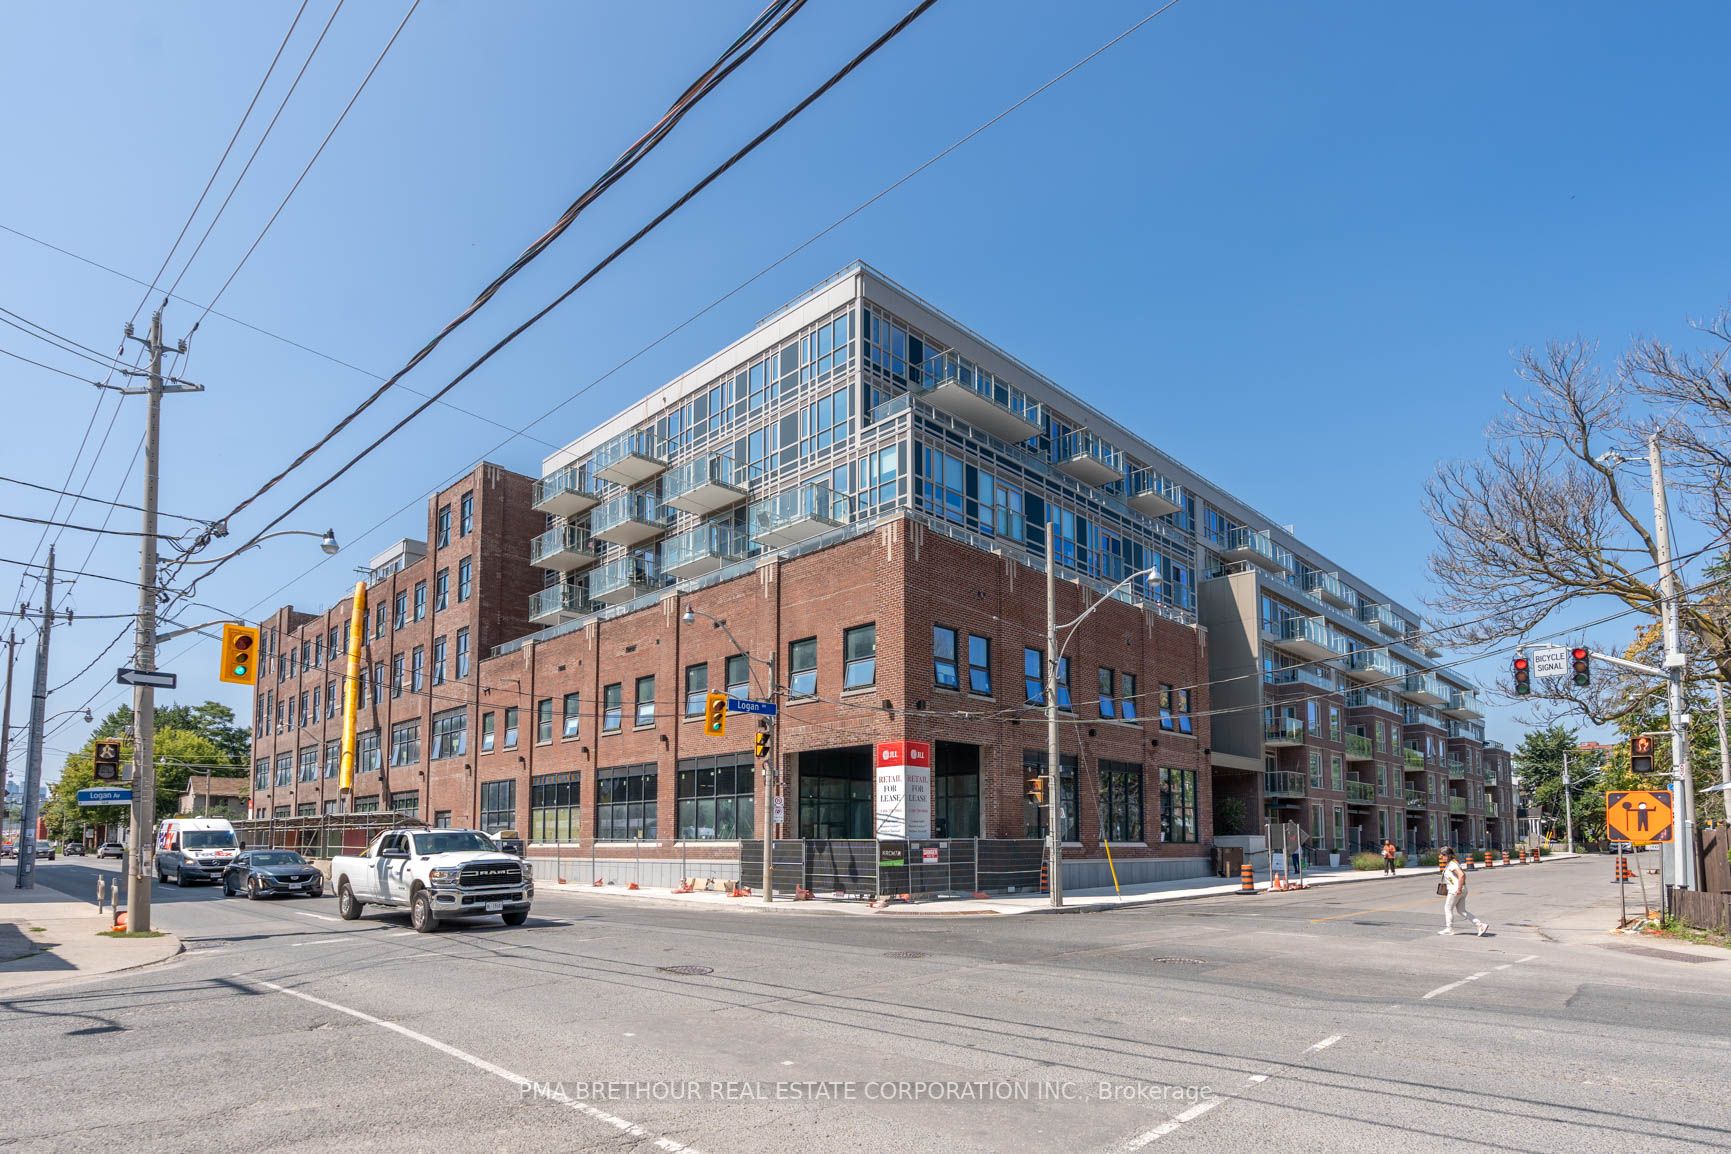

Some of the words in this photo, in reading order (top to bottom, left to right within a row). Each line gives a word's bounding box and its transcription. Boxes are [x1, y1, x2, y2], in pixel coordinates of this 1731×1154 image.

[1535, 652, 1565, 663] BICYCLE
[1537, 663, 1563, 671] SIGNAL
[737, 700, 760, 712] Logan
[878, 775, 902, 784] RETAIL
[908, 776, 928, 784] RETAIL
[90, 792, 111, 800] Logan
[880, 794, 901, 802] LEASE
